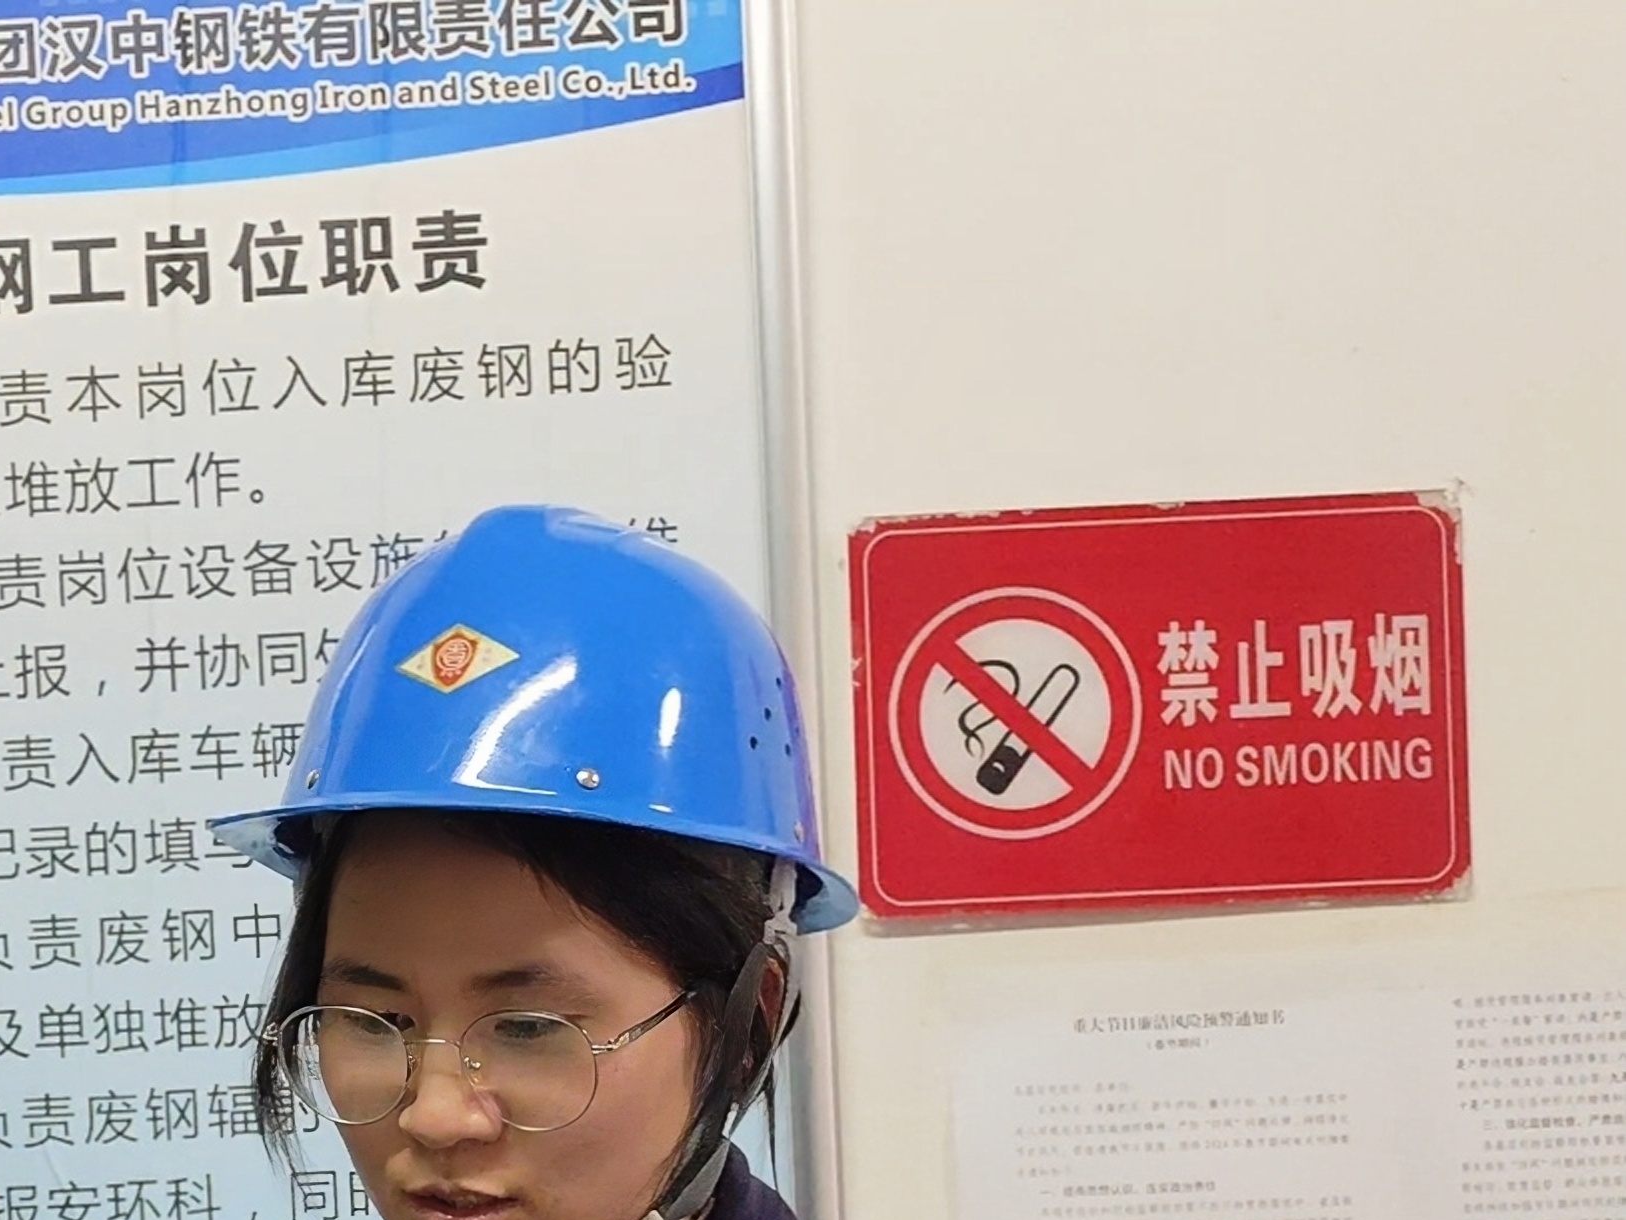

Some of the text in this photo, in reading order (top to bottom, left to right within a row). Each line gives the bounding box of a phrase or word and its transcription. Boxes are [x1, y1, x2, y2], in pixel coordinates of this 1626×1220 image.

[25, 98, 128, 128] Group
[140, 86, 308, 121] Hanzhong
[319, 84, 386, 108] Iron
[398, 75, 458, 105] and
[469, 69, 550, 99] Steel
[561, 63, 694, 95] Co.,Ltd.
[1157, 613, 1431, 727] 禁止吸烟
[1164, 740, 1433, 789] NO SMOKING
